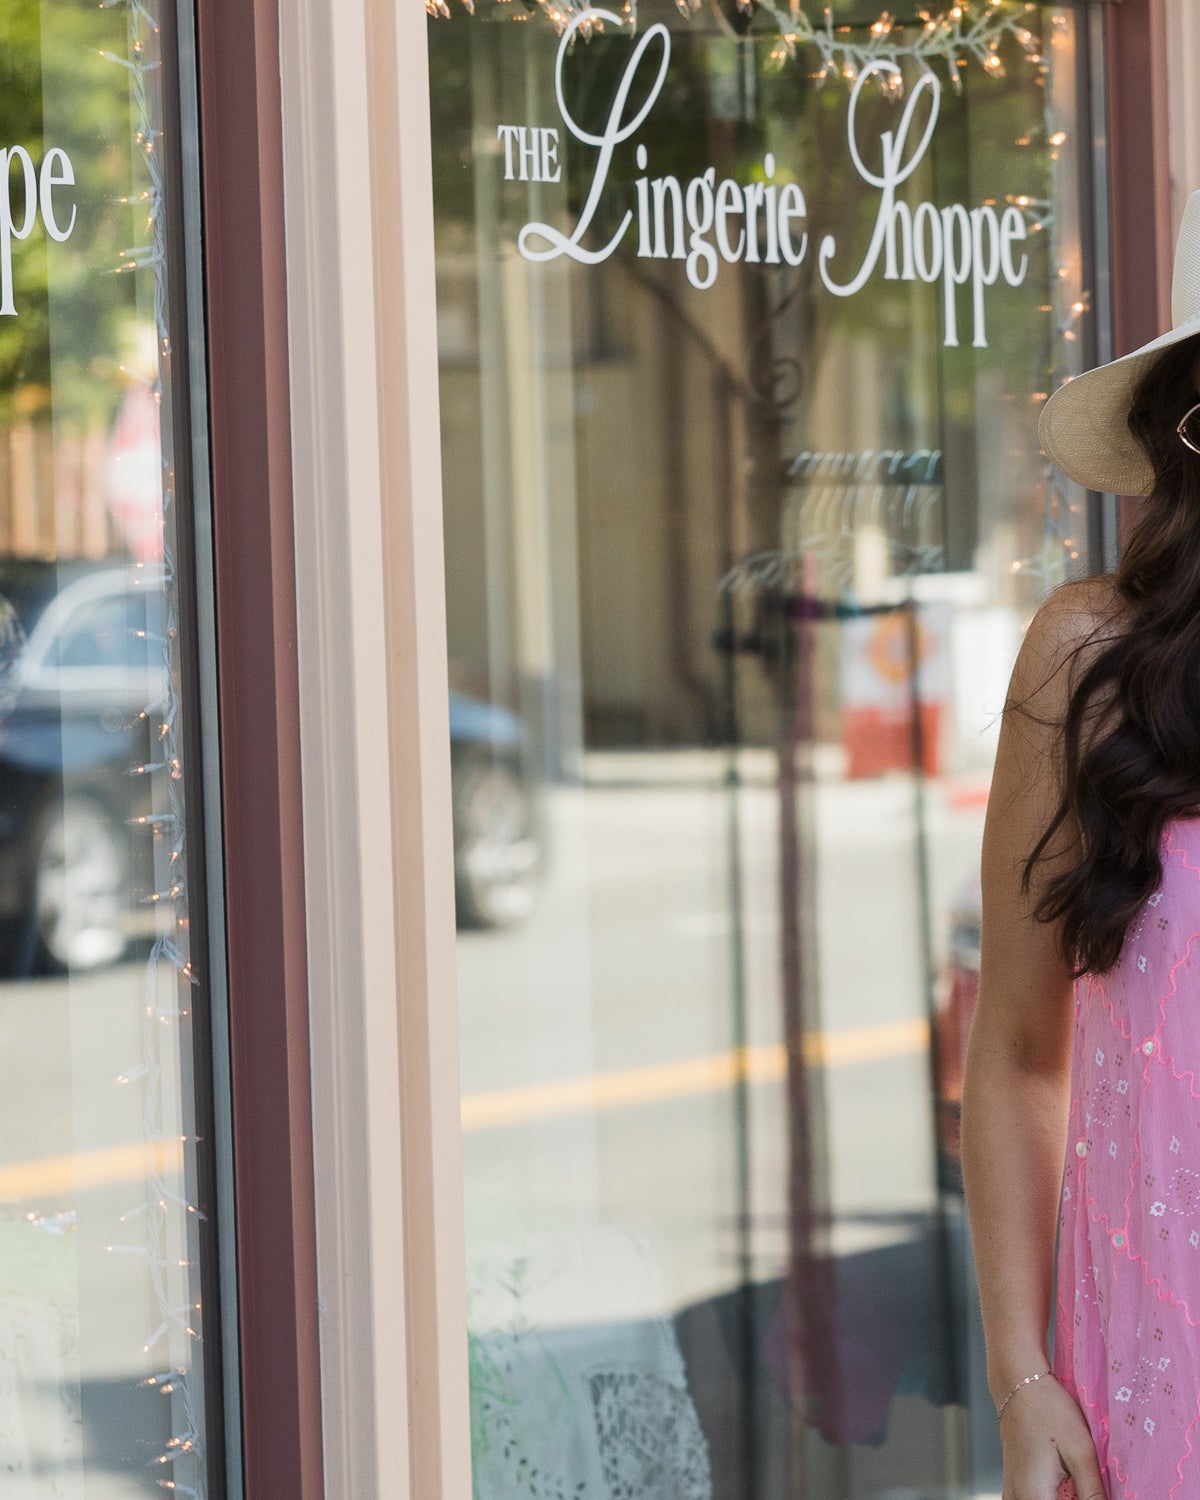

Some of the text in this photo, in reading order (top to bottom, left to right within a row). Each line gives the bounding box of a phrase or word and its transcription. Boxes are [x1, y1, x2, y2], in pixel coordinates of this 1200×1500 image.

[497, 8, 1029, 348] THE Lingerie Shoppe
